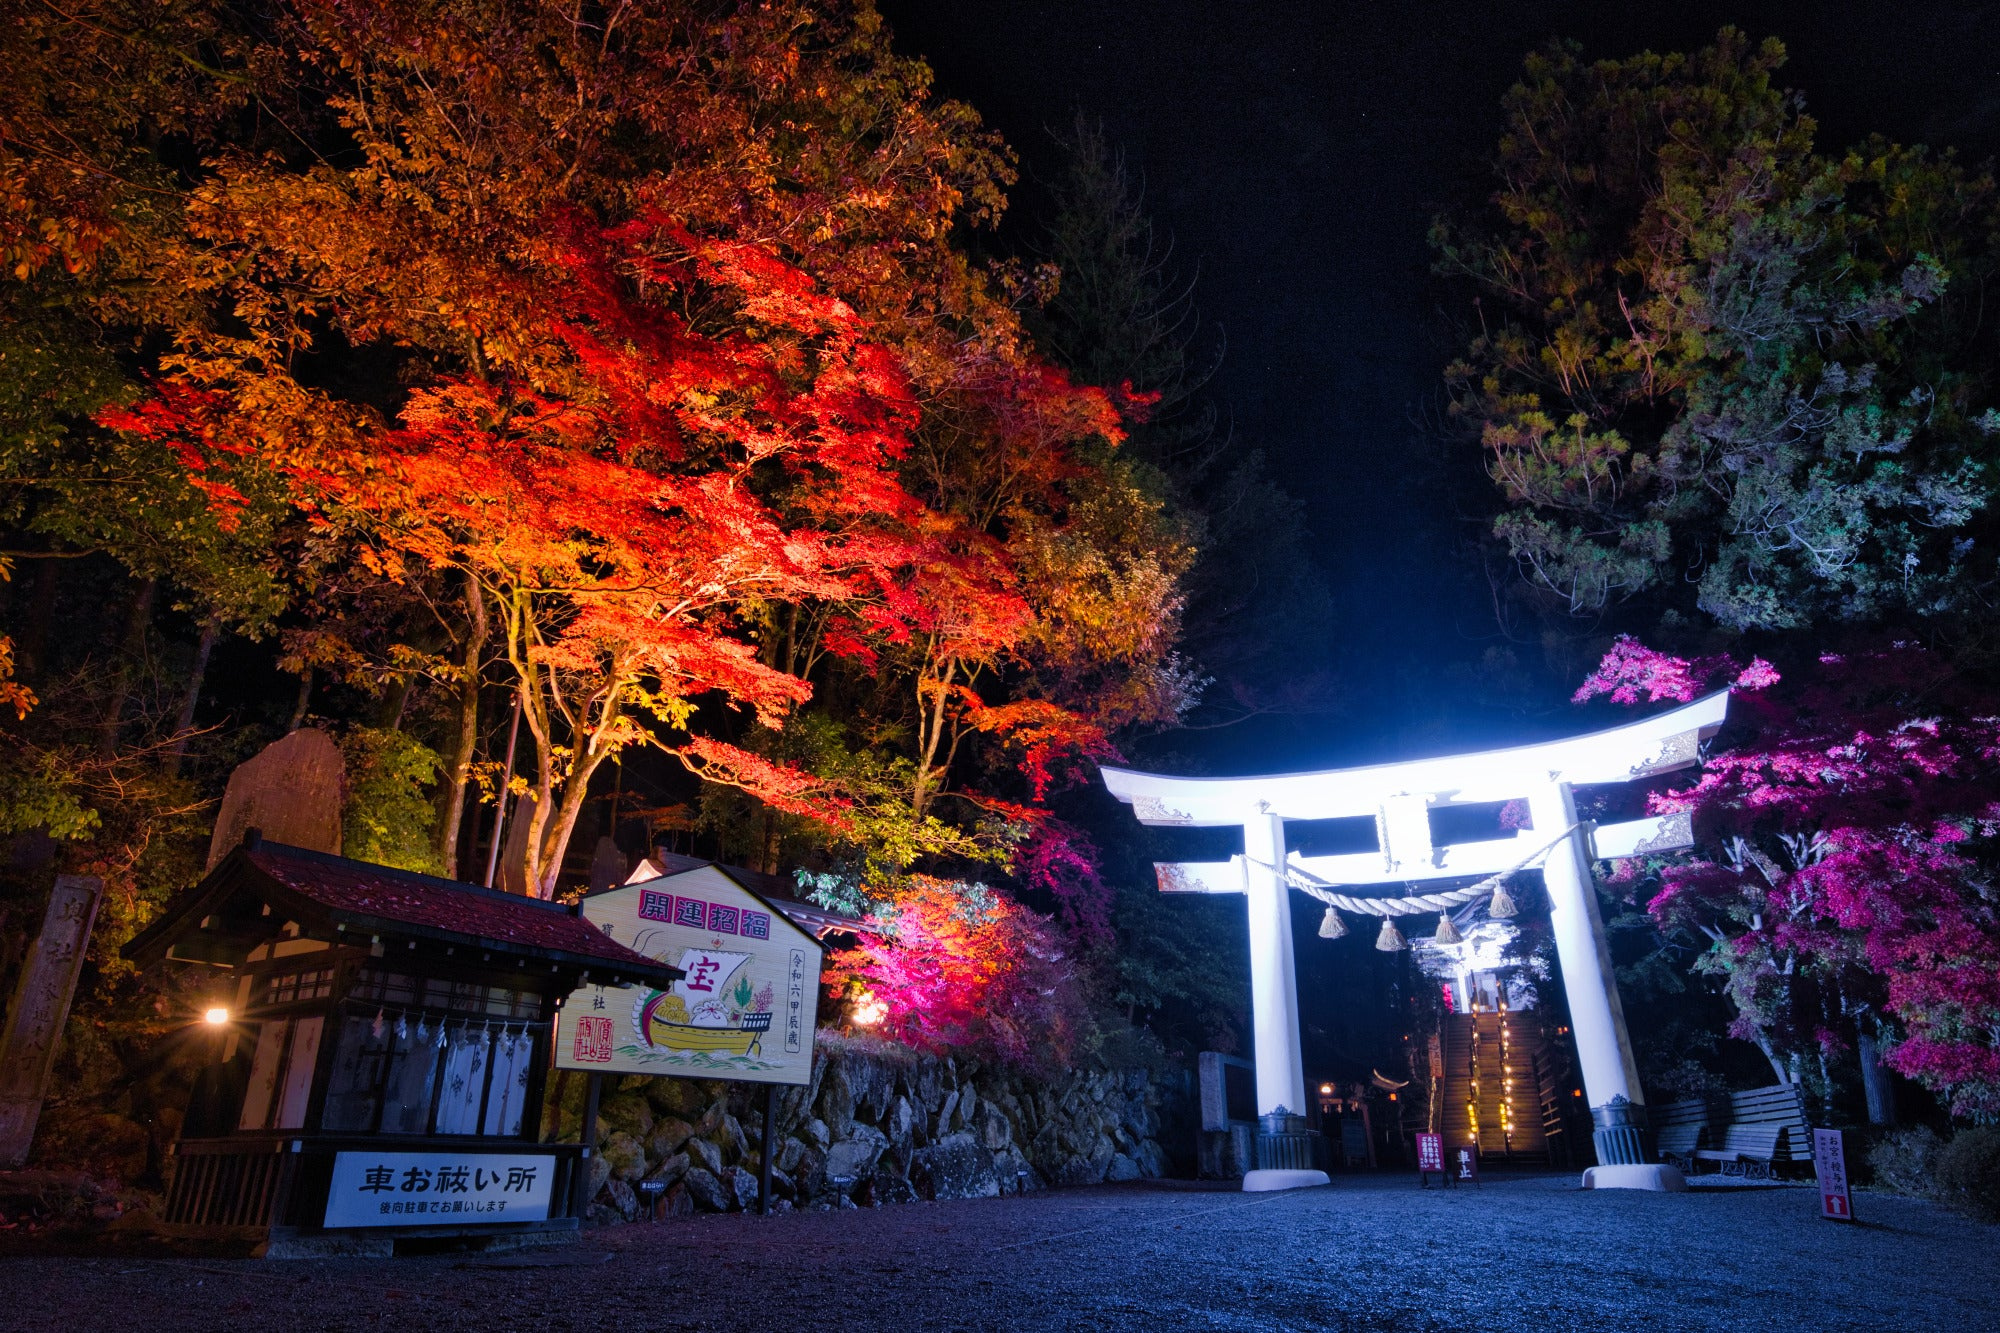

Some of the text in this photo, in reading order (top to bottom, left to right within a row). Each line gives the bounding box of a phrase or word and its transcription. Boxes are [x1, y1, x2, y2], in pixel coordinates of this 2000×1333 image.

[640, 892, 768, 938] 開運招福
[686, 956, 720, 993] 宝
[787, 954, 803, 1046] 令和六甲辰歳
[358, 1164, 537, 1194] 車お祓い所
[1457, 1150, 1473, 1178] 車止
[379, 1199, 508, 1214] 後向駐車でお願いします
